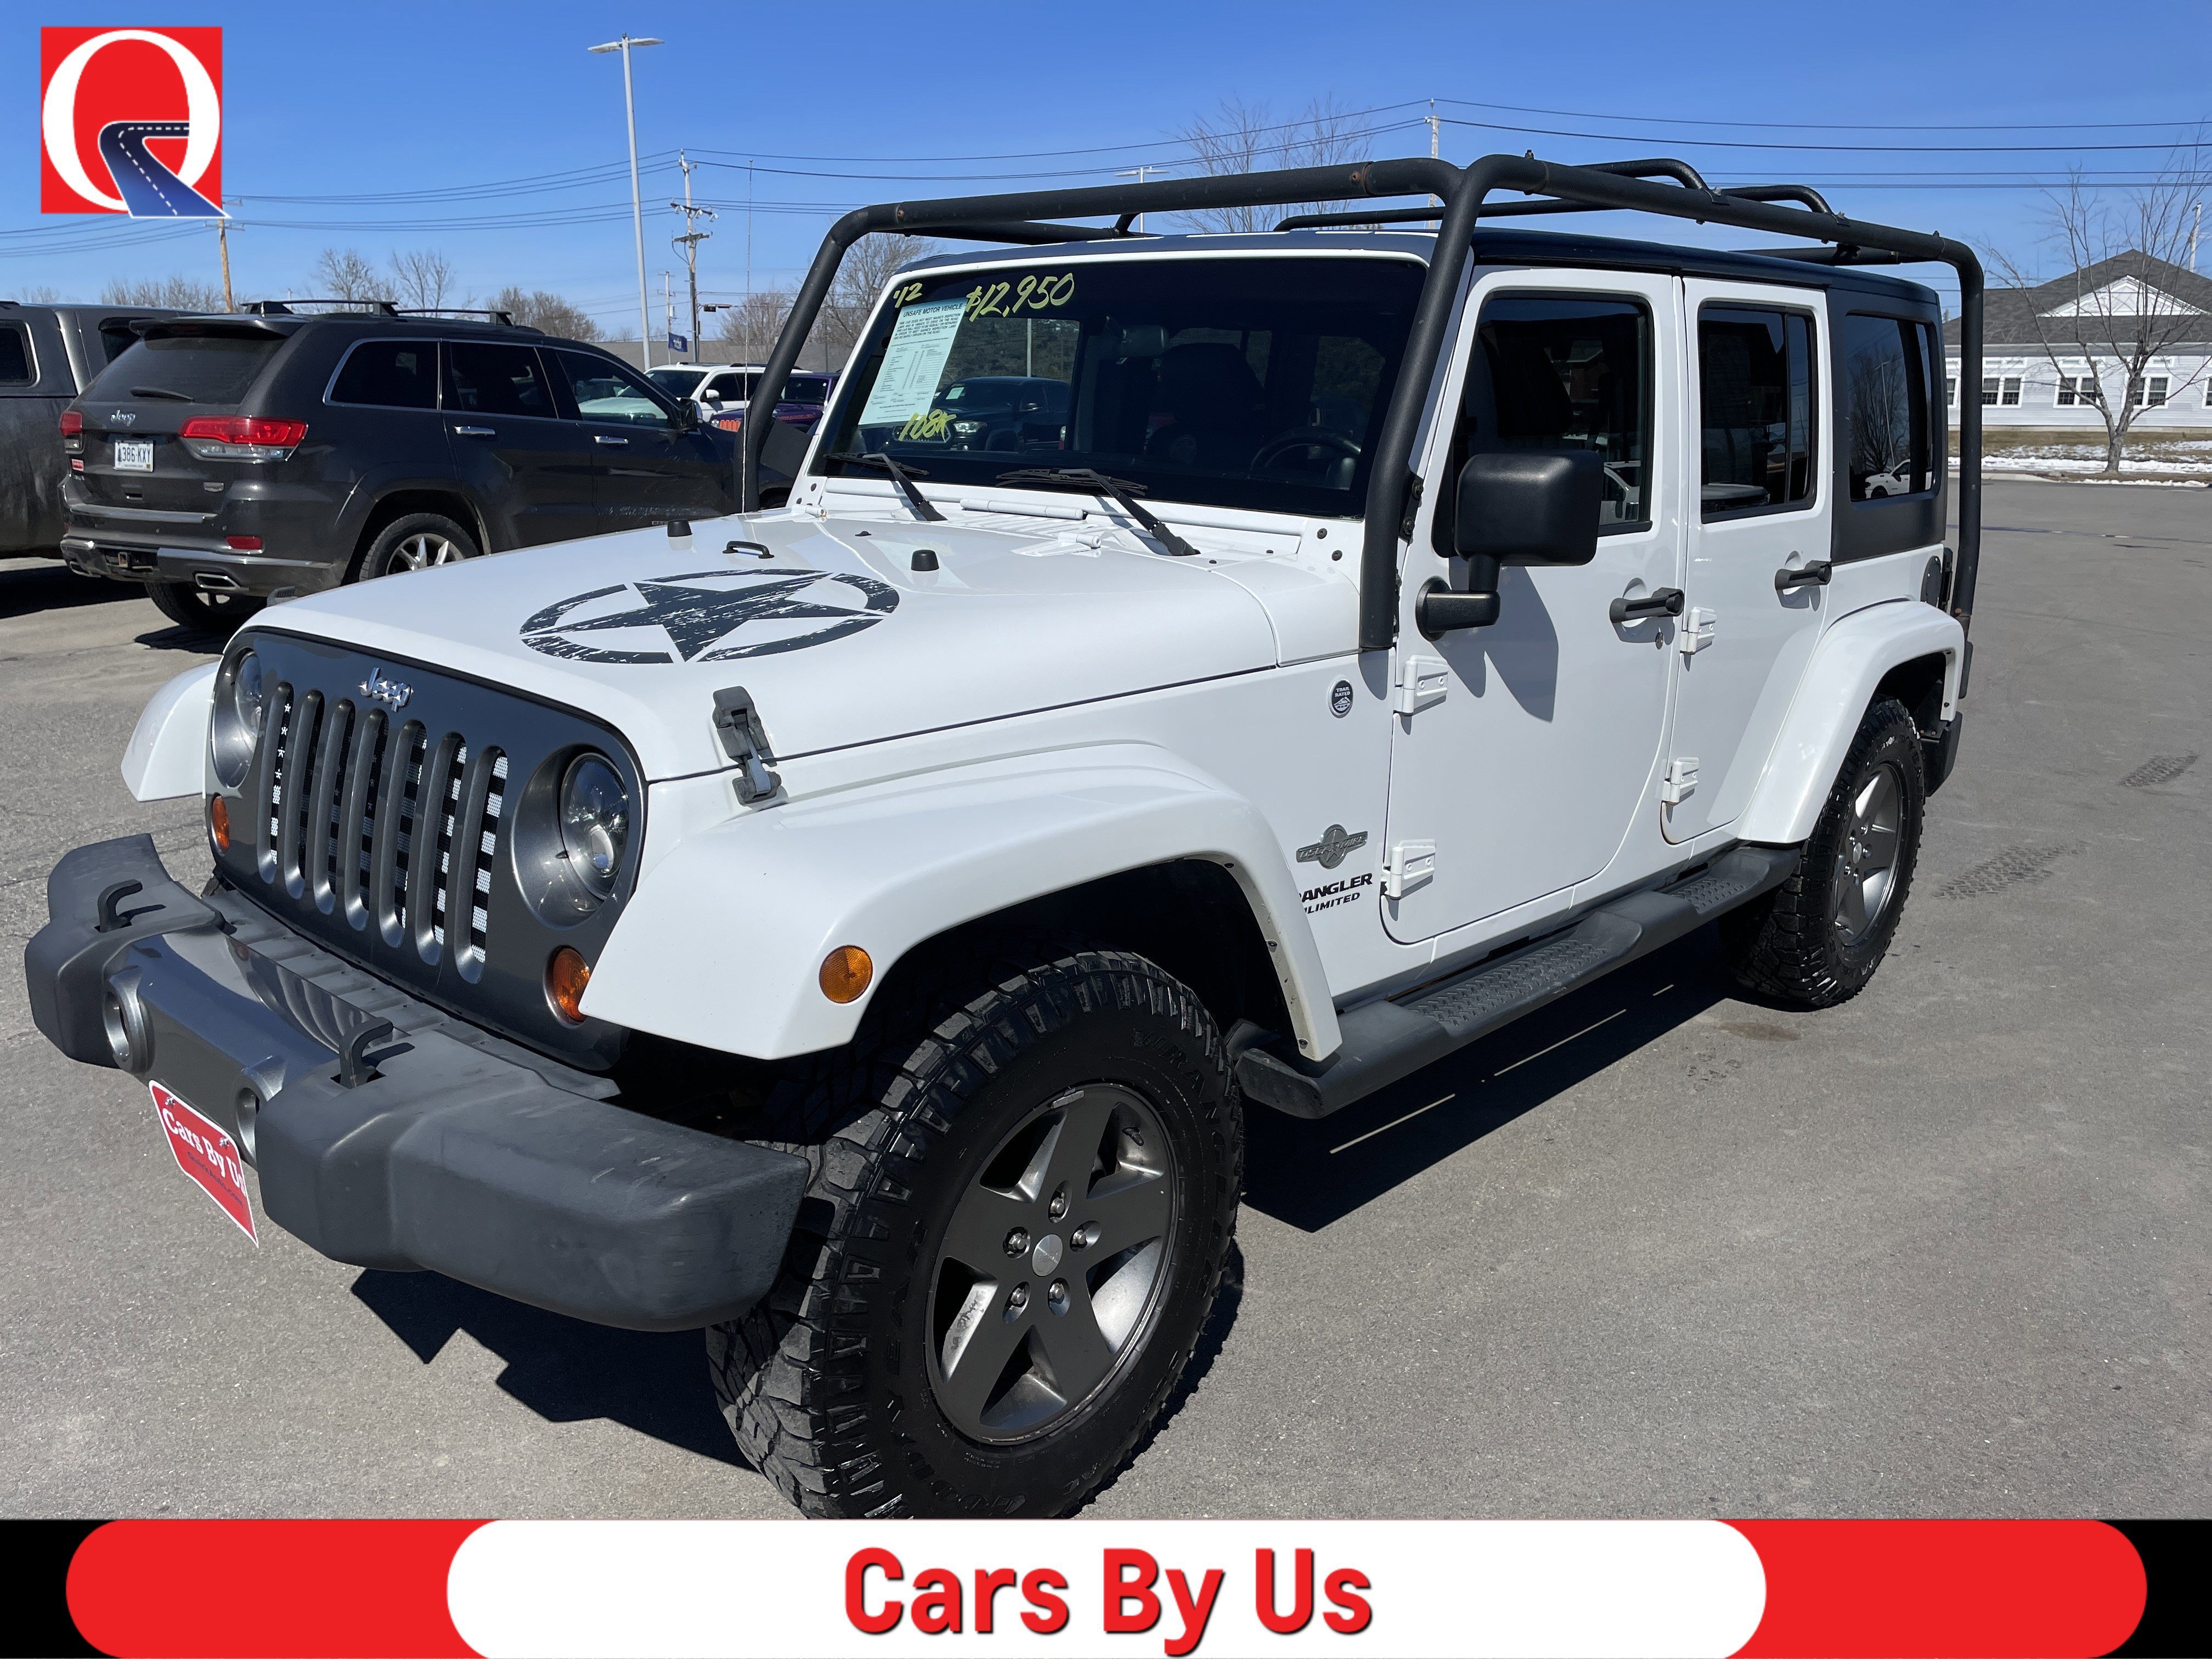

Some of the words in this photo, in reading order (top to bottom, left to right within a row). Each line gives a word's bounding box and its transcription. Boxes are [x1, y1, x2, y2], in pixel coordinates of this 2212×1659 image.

[903, 308, 923, 317] UNSAFE
[922, 306, 941, 314] MOTOR
[941, 303, 963, 312] VEHICLE
[965, 273, 1074, 323] $12,950
[111, 409, 136, 427] Jeep
[359, 667, 413, 713] Jeep
[1299, 872, 1373, 903] ANGLER
[1304, 892, 1361, 915] LIMITED
[162, 1108, 204, 1155] Cars
[201, 1136, 226, 1178] By
